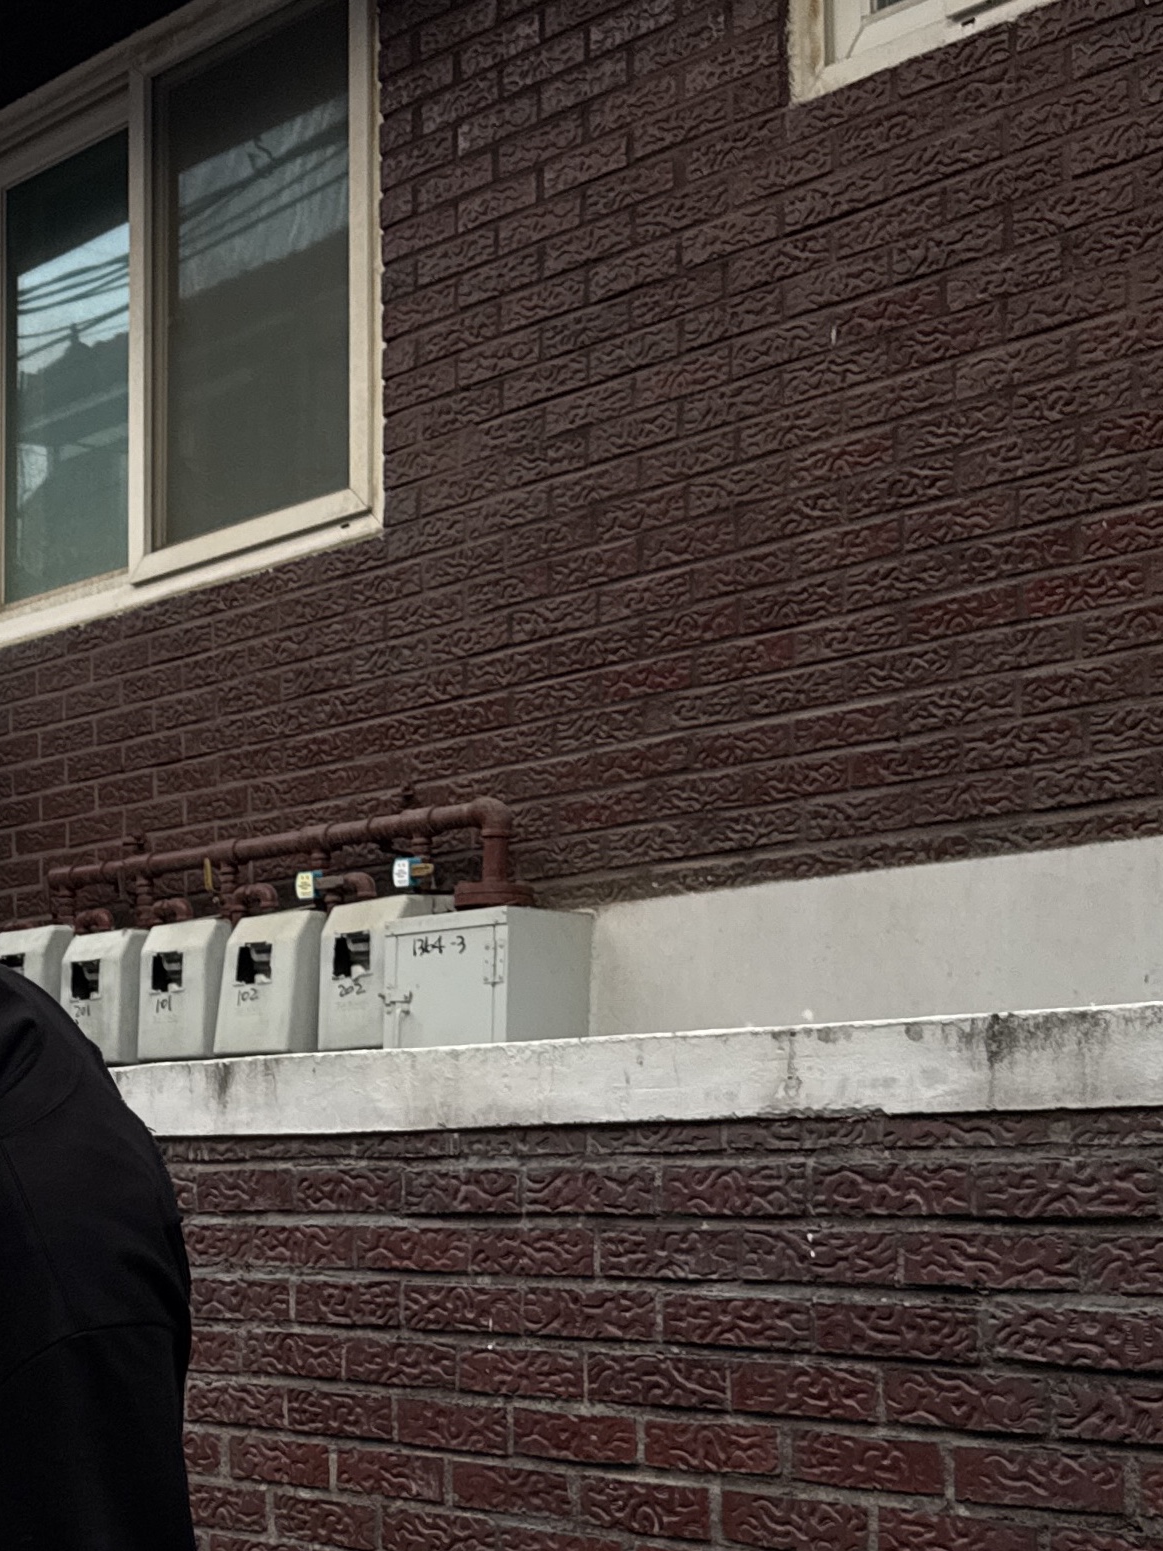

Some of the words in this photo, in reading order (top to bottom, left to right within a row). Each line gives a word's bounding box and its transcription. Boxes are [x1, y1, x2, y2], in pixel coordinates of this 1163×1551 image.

[236, 987, 259, 1006] 102
[337, 981, 366, 998] 202
[73, 1004, 91, 1018] 201
[155, 994, 172, 1014] 101
